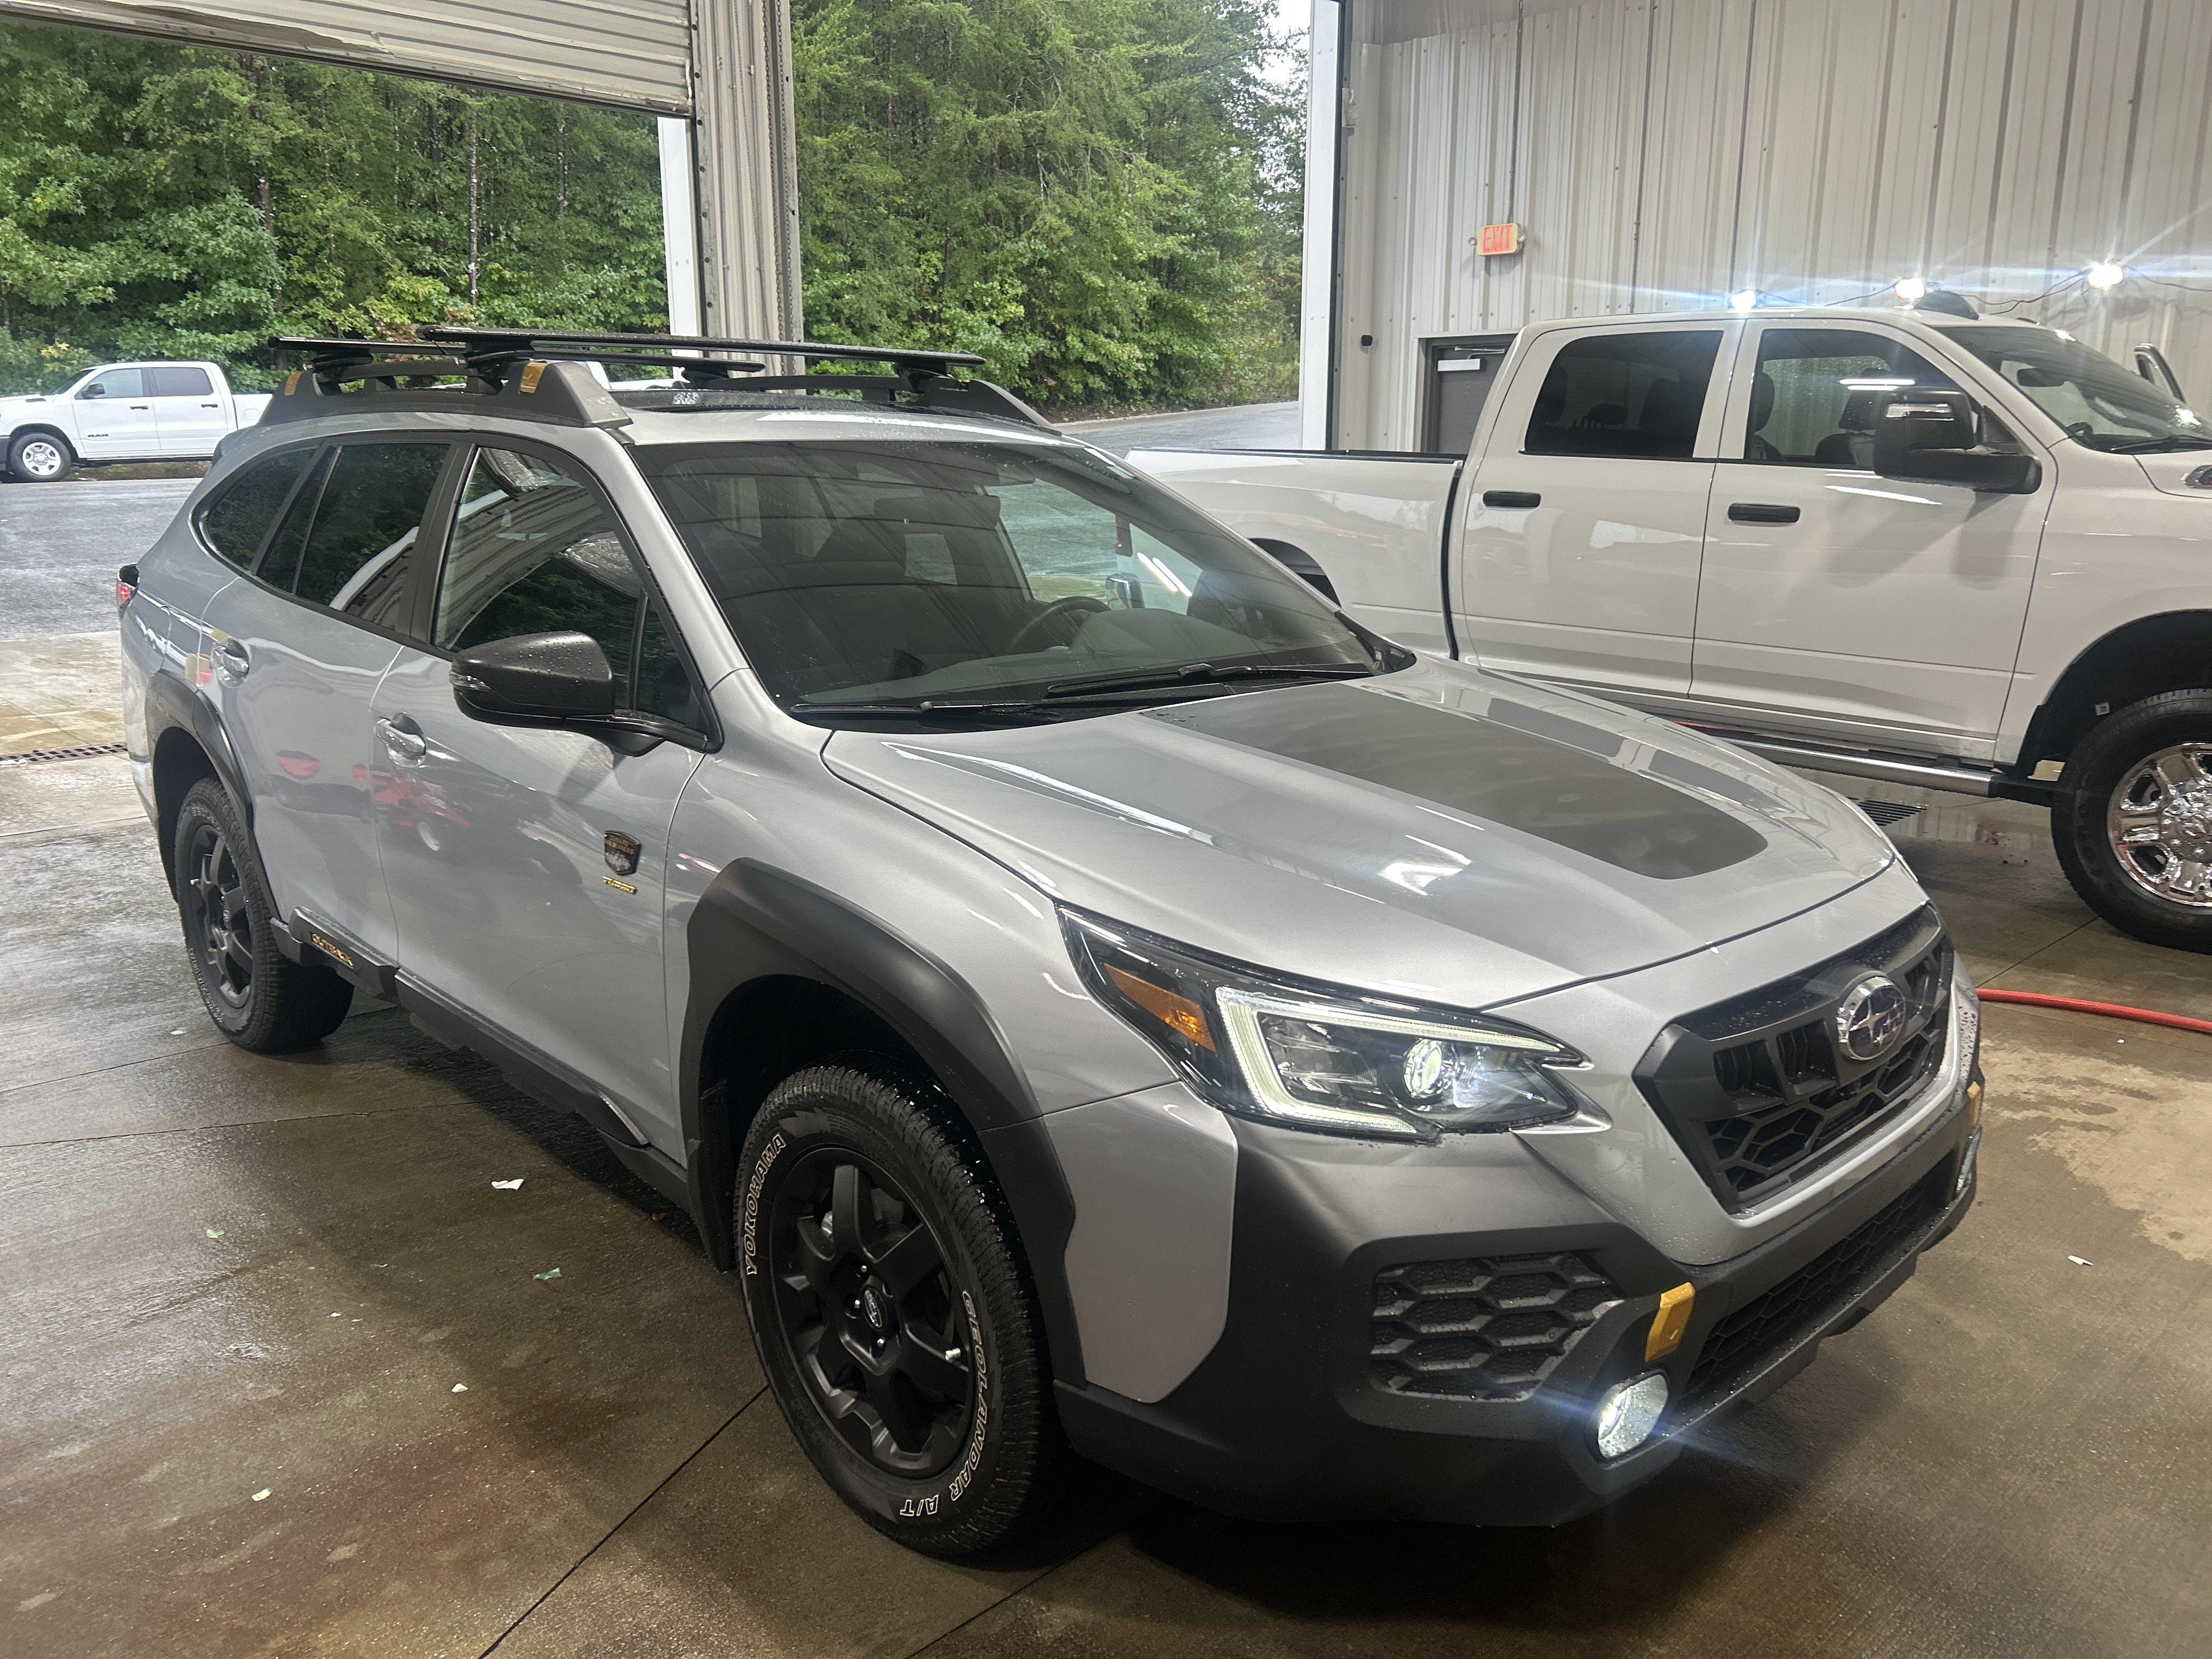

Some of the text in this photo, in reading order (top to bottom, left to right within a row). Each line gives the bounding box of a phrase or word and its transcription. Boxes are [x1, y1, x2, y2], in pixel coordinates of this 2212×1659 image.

[1483, 224, 1513, 253] EXIT
[743, 1132, 787, 1276] YOKOHAMA
[900, 1290, 988, 1517] GEOLANDAR A/T
